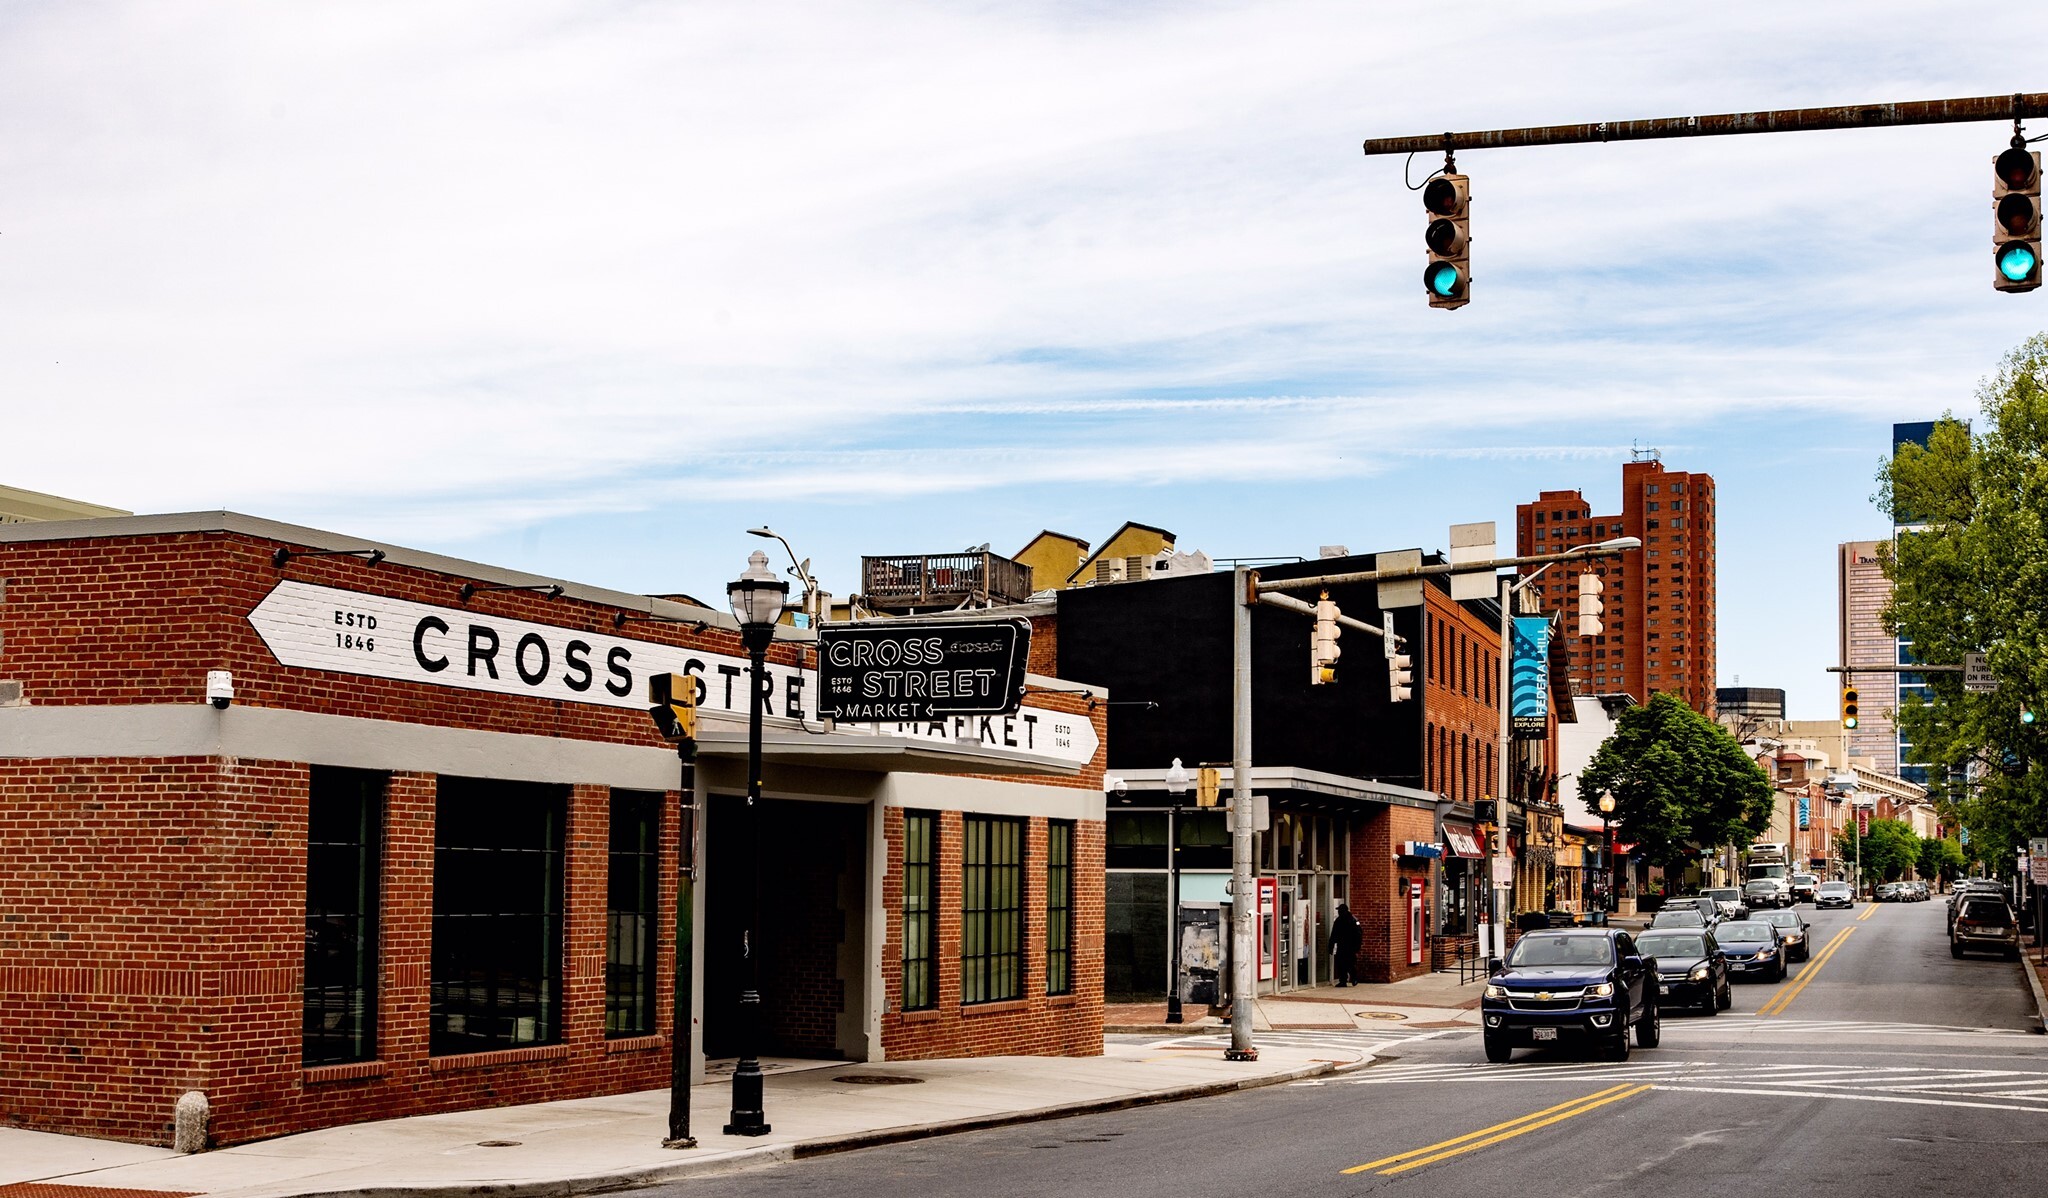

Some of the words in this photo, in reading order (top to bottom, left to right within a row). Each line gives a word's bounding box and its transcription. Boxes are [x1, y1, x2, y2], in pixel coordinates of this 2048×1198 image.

[334, 610, 378, 630] ESTD
[335, 633, 376, 652] 1846
[1537, 625, 1547, 654] HILL
[829, 637, 944, 667] CROSS
[412, 615, 633, 697] CROSS
[683, 658, 806, 720] STRE
[831, 676, 853, 686] ESTD
[831, 685, 852, 694] 1846
[862, 669, 996, 698] STREET
[1536, 656, 1547, 715] FEDERAL
[845, 703, 920, 718] MARKET
[1055, 724, 1071, 735] ESTD
[1055, 738, 1070, 748] 1846
